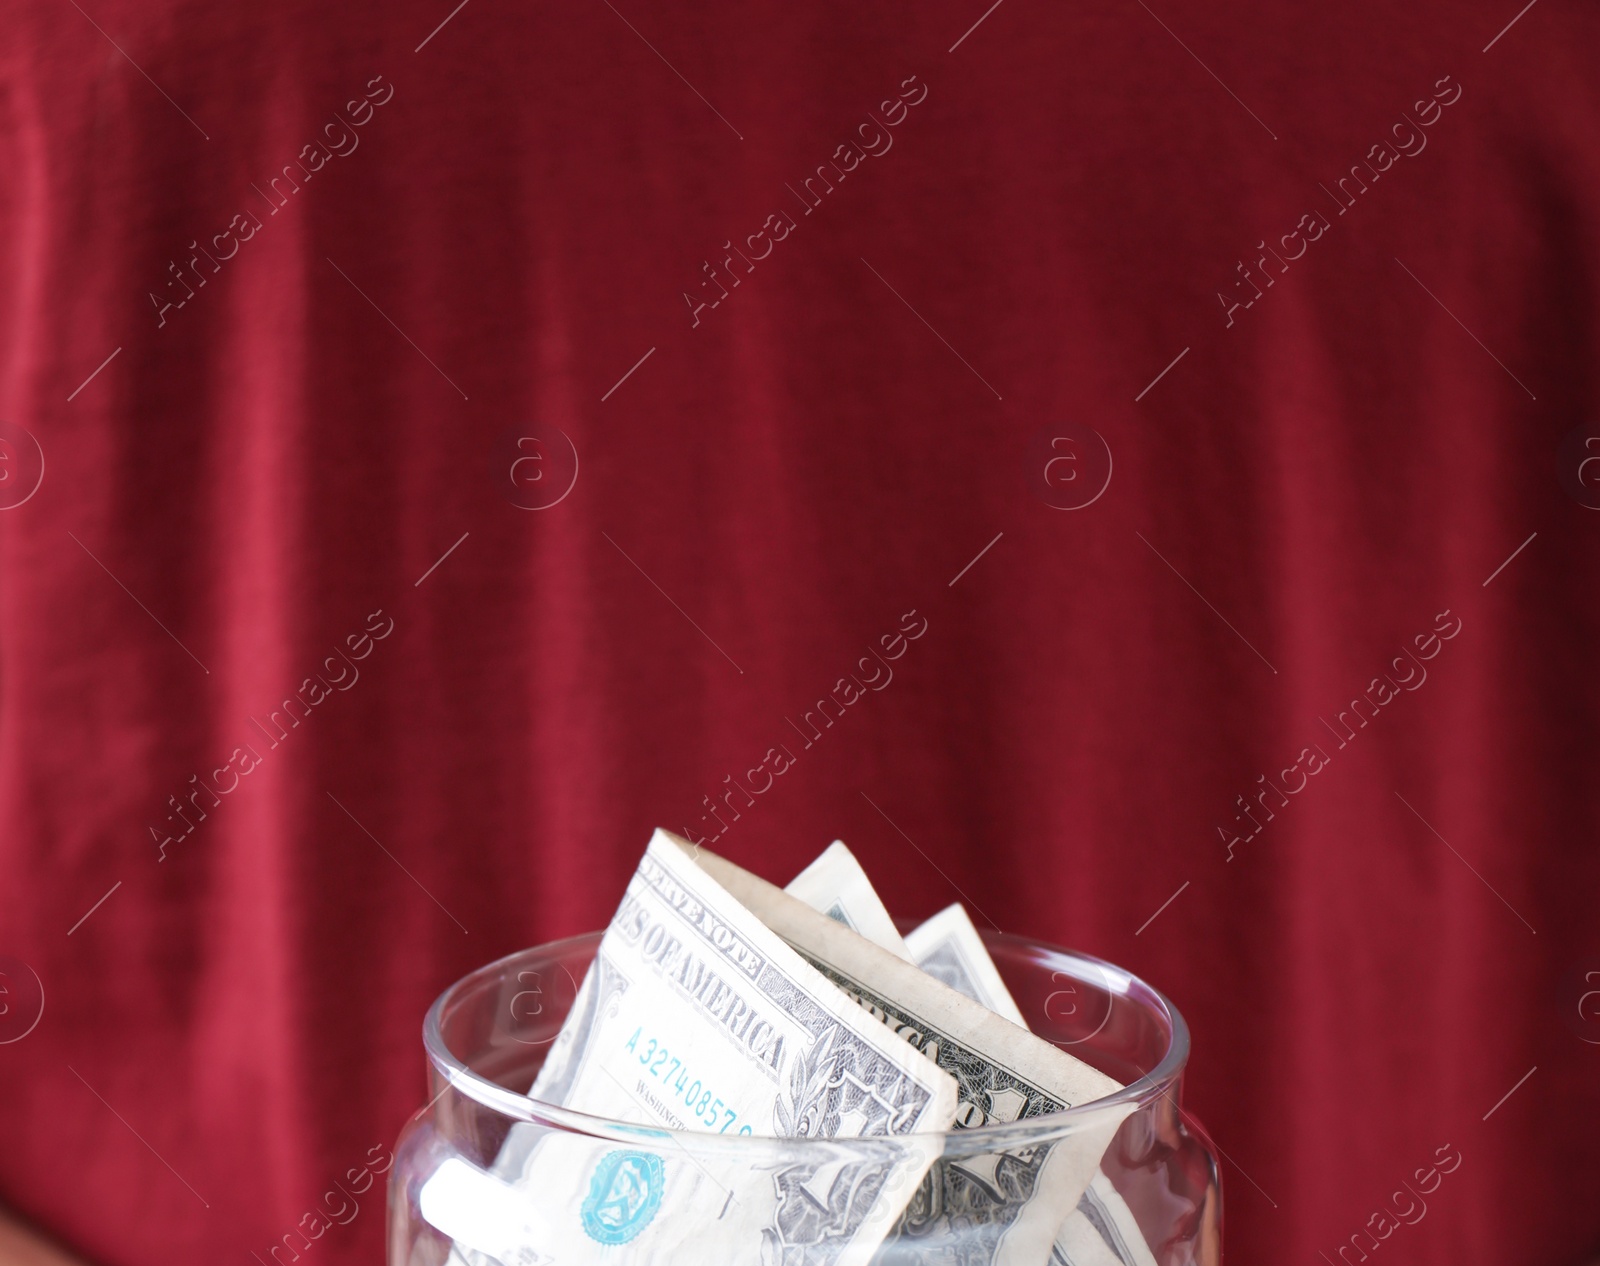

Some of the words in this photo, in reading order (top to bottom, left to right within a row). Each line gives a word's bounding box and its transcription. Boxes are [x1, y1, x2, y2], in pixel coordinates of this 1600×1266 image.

[643, 922, 683, 967] OF
[670, 951, 786, 1069] AMERICA
[696, 910, 765, 979] NOTE
